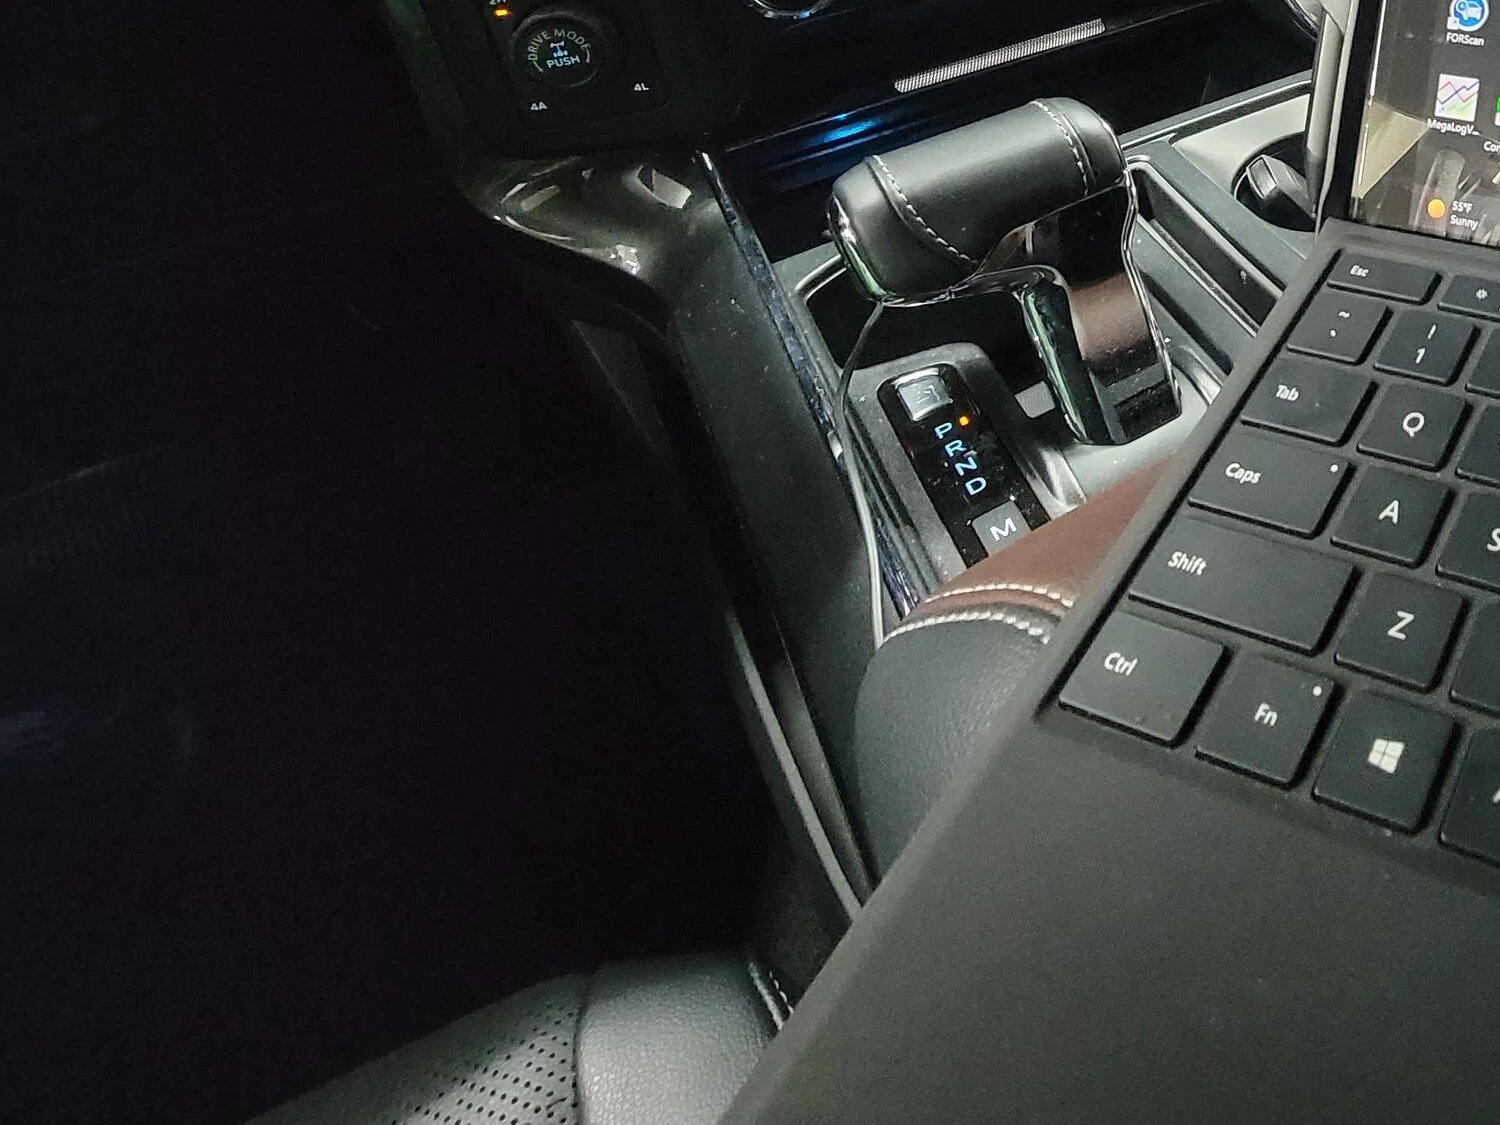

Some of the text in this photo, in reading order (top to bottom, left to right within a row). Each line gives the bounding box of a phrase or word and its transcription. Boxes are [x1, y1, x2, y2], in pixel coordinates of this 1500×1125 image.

[528, 29, 590, 61] DRIVE MODE
[1446, 33, 1484, 46] FORScan
[547, 55, 580, 68] PUSH
[634, 83, 649, 92] 4L
[530, 101, 547, 111] 4A
[1452, 201, 1472, 212] 55°F
[1451, 216, 1478, 230] Sunny
[1350, 265, 1369, 277] Esc
[1275, 385, 1299, 402] Tab
[935, 422, 952, 439] P
[1402, 413, 1425, 437] Q
[945, 439, 967, 457] R
[954, 457, 978, 476] N
[1226, 463, 1261, 484] Caps
[965, 477, 986, 496] D
[1379, 500, 1398, 524] A
[990, 517, 1017, 541] M
[1169, 551, 1207, 576] Shift
[1388, 612, 1414, 639] Z
[1104, 651, 1137, 676] Ctrl
[1255, 703, 1278, 727] Fn
